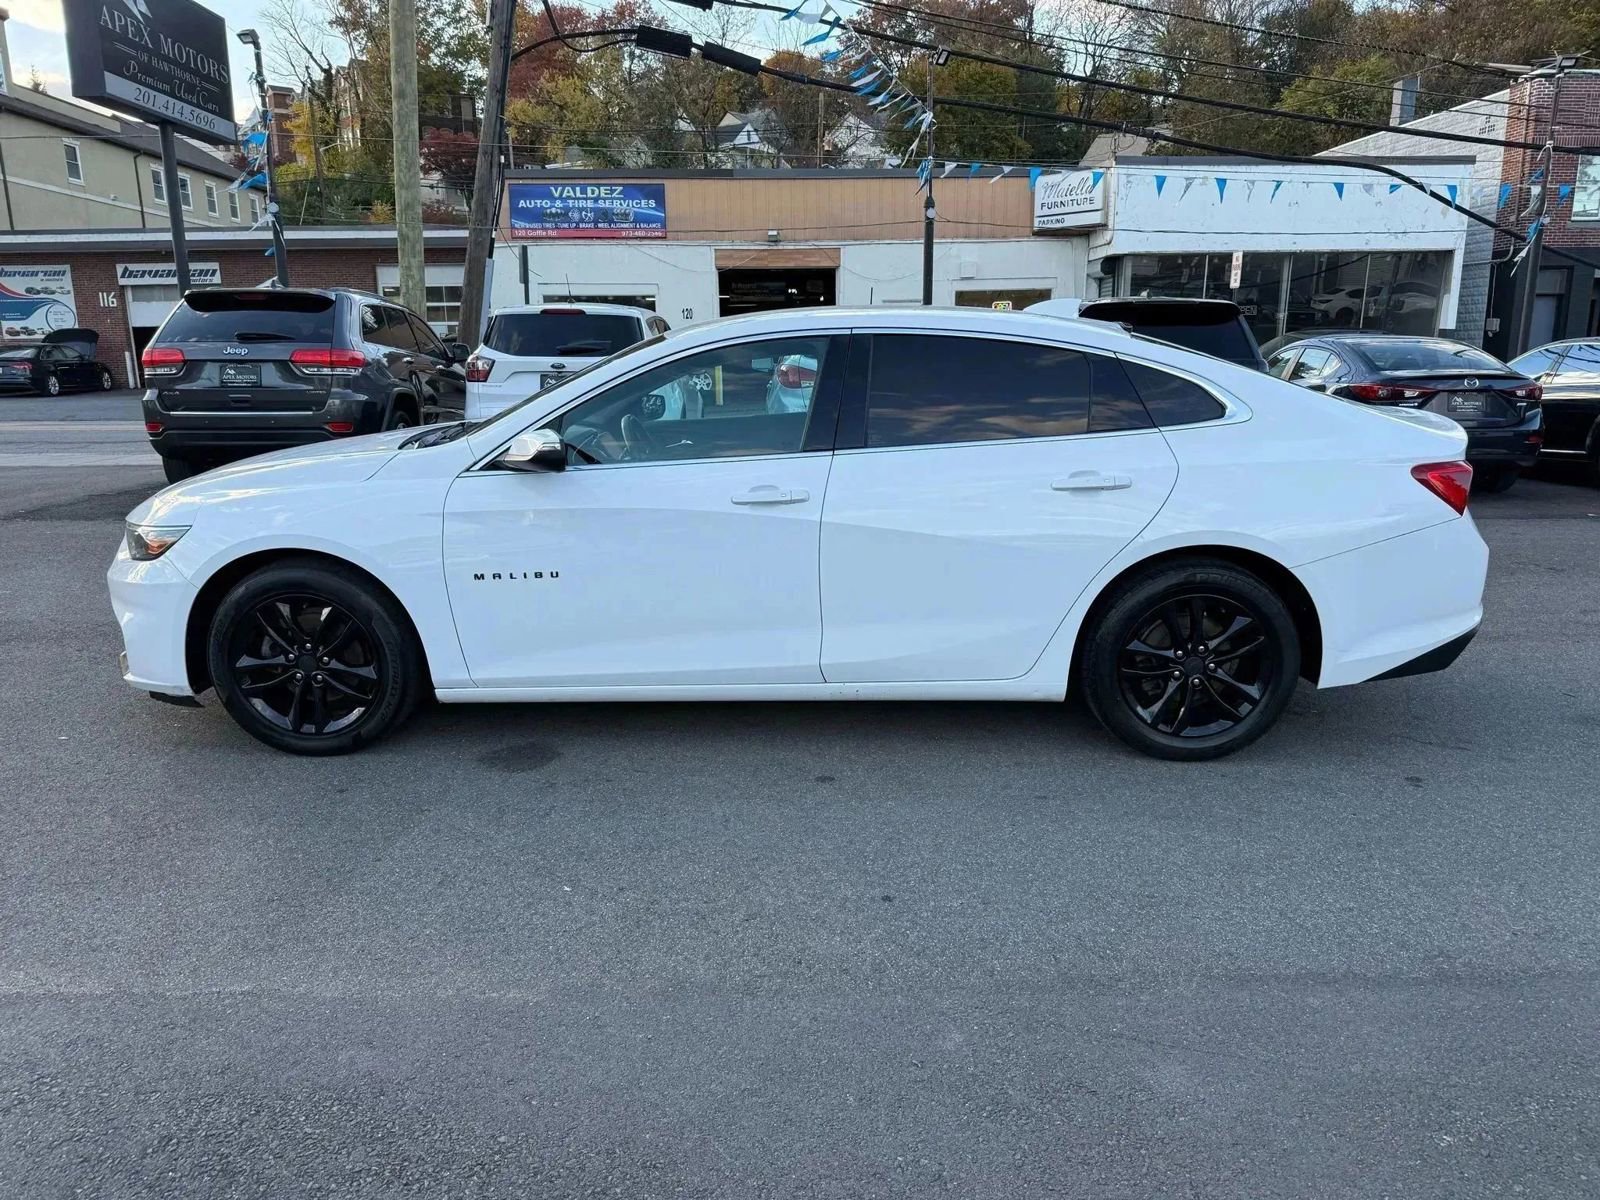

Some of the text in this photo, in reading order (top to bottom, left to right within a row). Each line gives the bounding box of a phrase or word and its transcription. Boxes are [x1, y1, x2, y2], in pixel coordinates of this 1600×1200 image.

[100, 5, 229, 84] APEX MOTORS
[138, 51, 202, 87] OF HAWTHORNE
[123, 60, 219, 113] Premium Used Cars
[134, 87, 216, 130] 201.414.5696
[550, 186, 624, 198] VALDEZ
[518, 199, 656, 208] AUTO & TIRE SERVICES
[1040, 196, 1095, 211] FURNITURE
[1038, 218, 1065, 226] PARKING
[98, 291, 118, 307] 116
[681, 307, 694, 320] 120
[223, 346, 249, 356] Jeep
[473, 570, 560, 581] MALIBU
